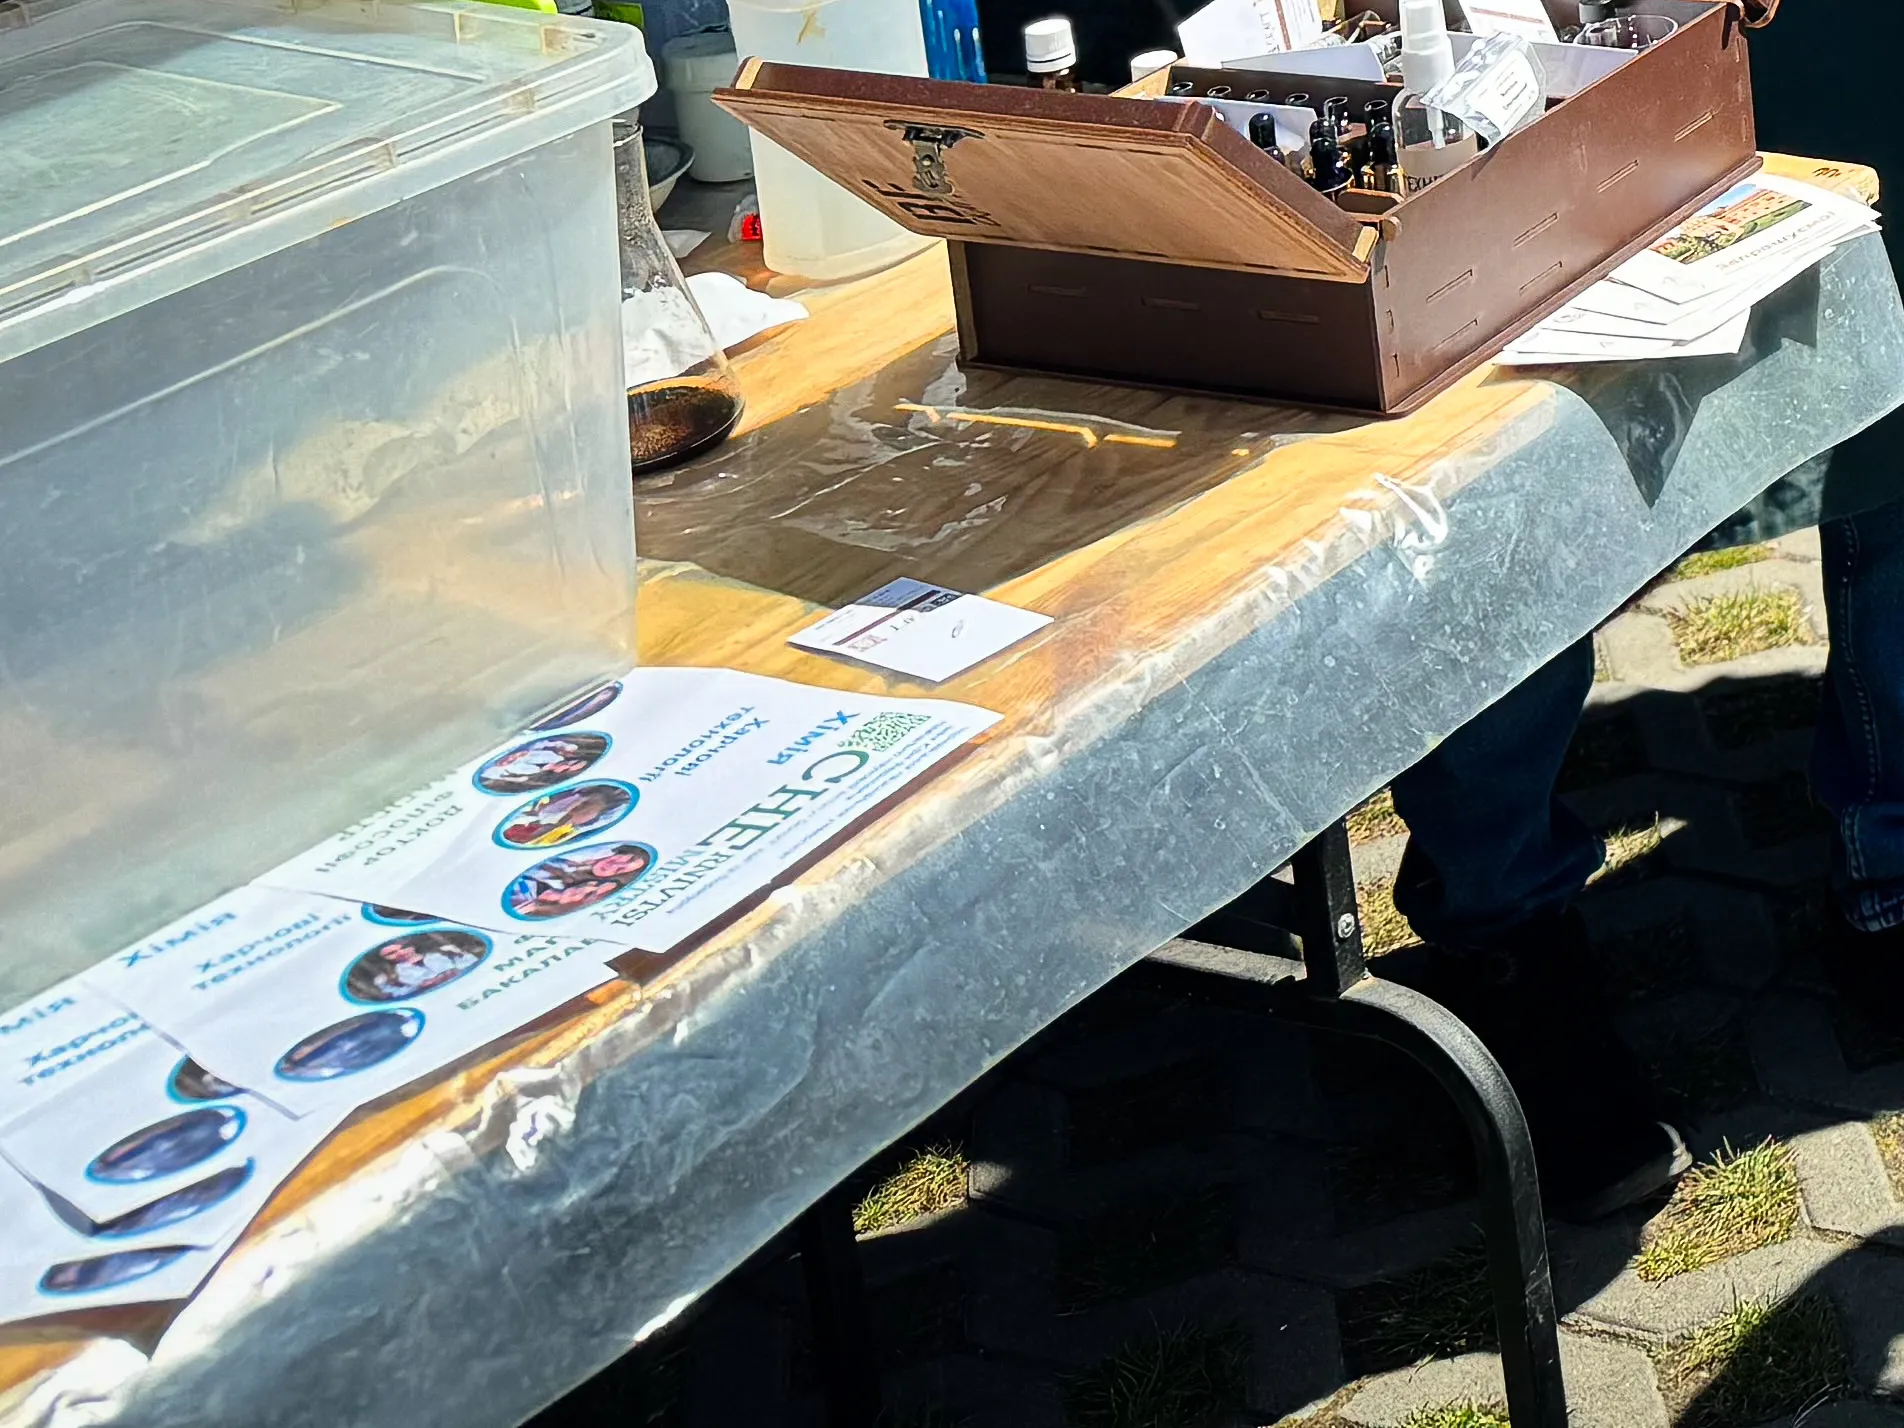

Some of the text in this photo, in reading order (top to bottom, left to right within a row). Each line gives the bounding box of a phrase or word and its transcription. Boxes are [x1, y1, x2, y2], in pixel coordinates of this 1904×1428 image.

[638, 705, 757, 784] технології
[674, 717, 770, 777] Харчові
[766, 710, 861, 766] Хімія
[362, 804, 463, 867] ДОКТОР
[117, 911, 239, 969] Хімія
[190, 913, 352, 991] технології
[193, 912, 322, 974] Харчові
[456, 937, 598, 1011] БАКАЛА
